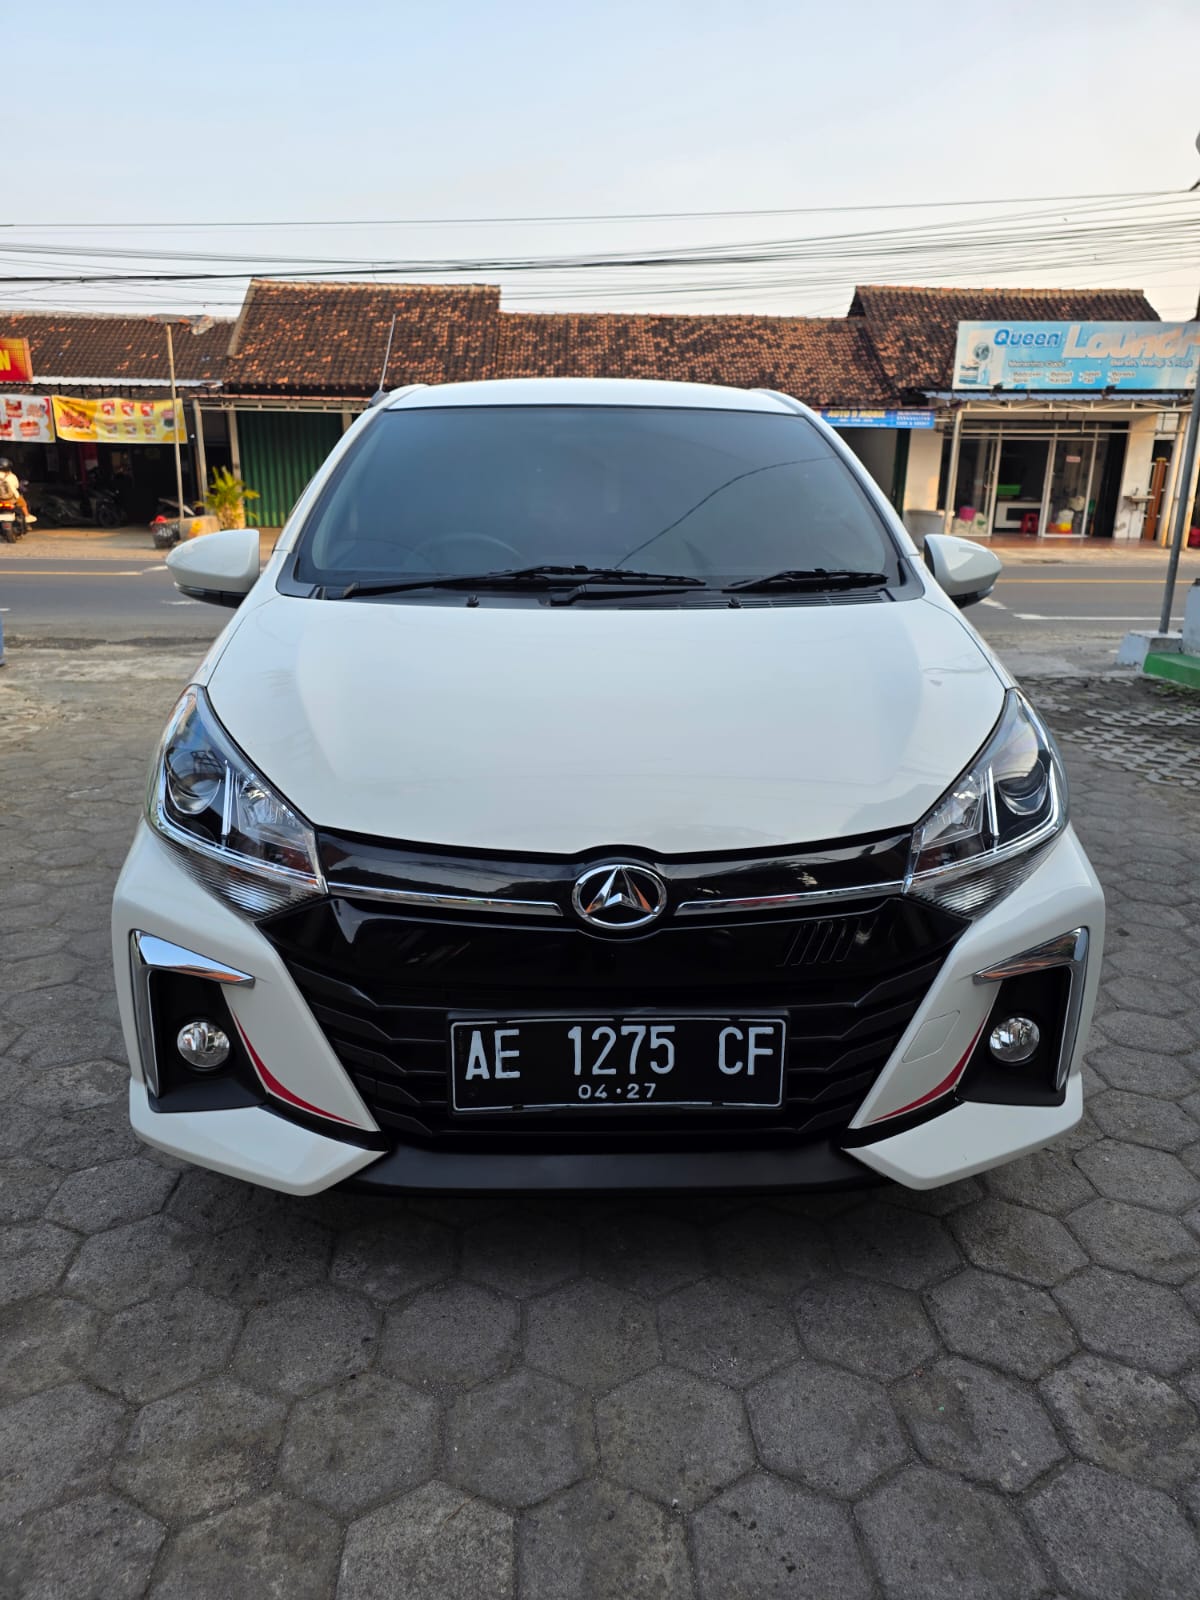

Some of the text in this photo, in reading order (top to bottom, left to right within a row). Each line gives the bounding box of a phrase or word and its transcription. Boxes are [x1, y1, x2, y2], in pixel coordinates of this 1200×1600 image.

[994, 329, 1060, 346] Queen
[465, 1025, 774, 1080] AE 1275 CF
